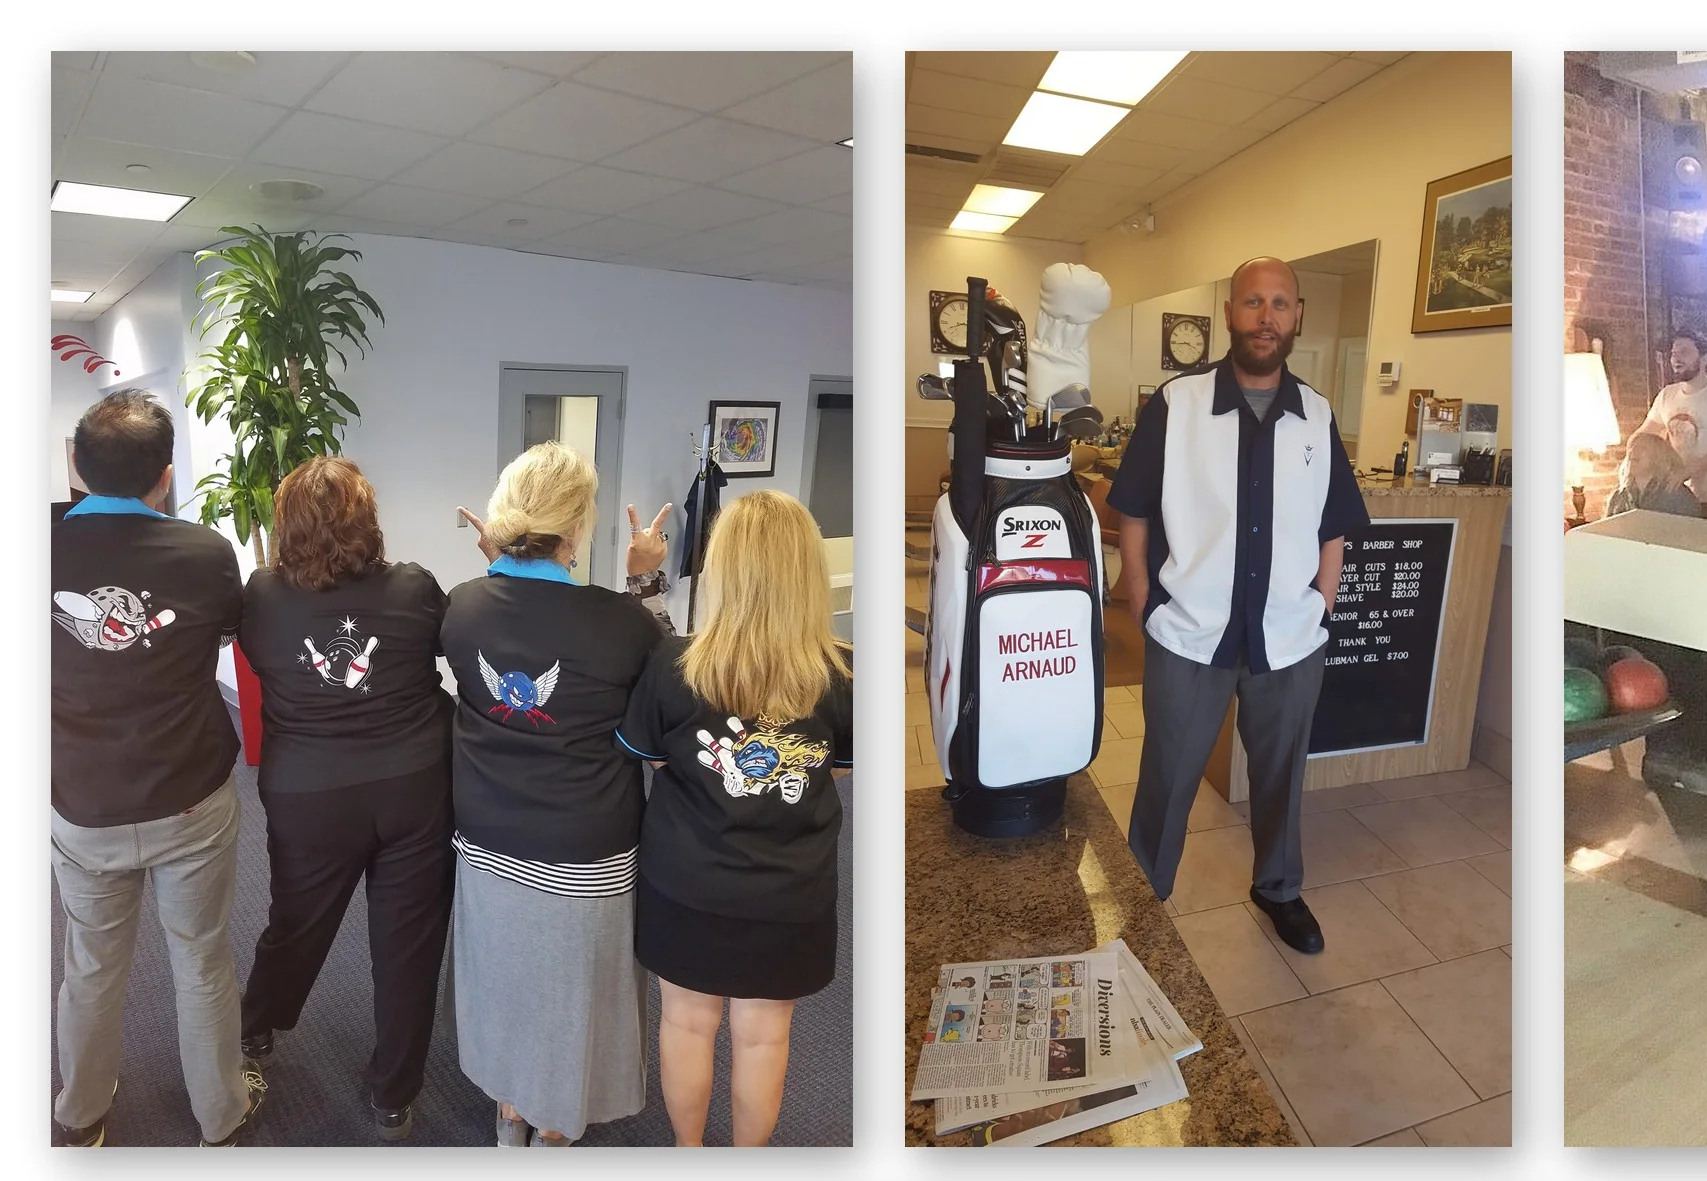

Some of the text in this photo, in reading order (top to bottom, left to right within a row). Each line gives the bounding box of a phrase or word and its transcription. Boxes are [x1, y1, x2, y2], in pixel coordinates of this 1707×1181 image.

[1002, 517, 1062, 534] SRIXON
[1020, 534, 1048, 548] Z
[1363, 541, 1395, 550] BARBER
[1402, 540, 1423, 549] SHOP
[1341, 562, 1423, 572] AIR CUTS $18.00
[1364, 573, 1381, 581] CUT
[1393, 572, 1421, 580] $20.00
[1355, 583, 1381, 592] STYLE
[1392, 581, 1420, 590] $24.00
[1336, 590, 1419, 603] SHAVE $20.00
[1369, 611, 1379, 619] 65
[1382, 610, 1389, 618] &
[1392, 609, 1415, 618] OVER
[1358, 620, 1383, 629] $16.00
[998, 629, 1078, 655] MICHAEL
[1338, 636, 1391, 647] THANK YOU
[1325, 655, 1359, 666] LUBMAN
[1363, 654, 1379, 662] GEL
[1002, 656, 1076, 683] ARNAUD
[1098, 979, 1116, 1056] Diversions
